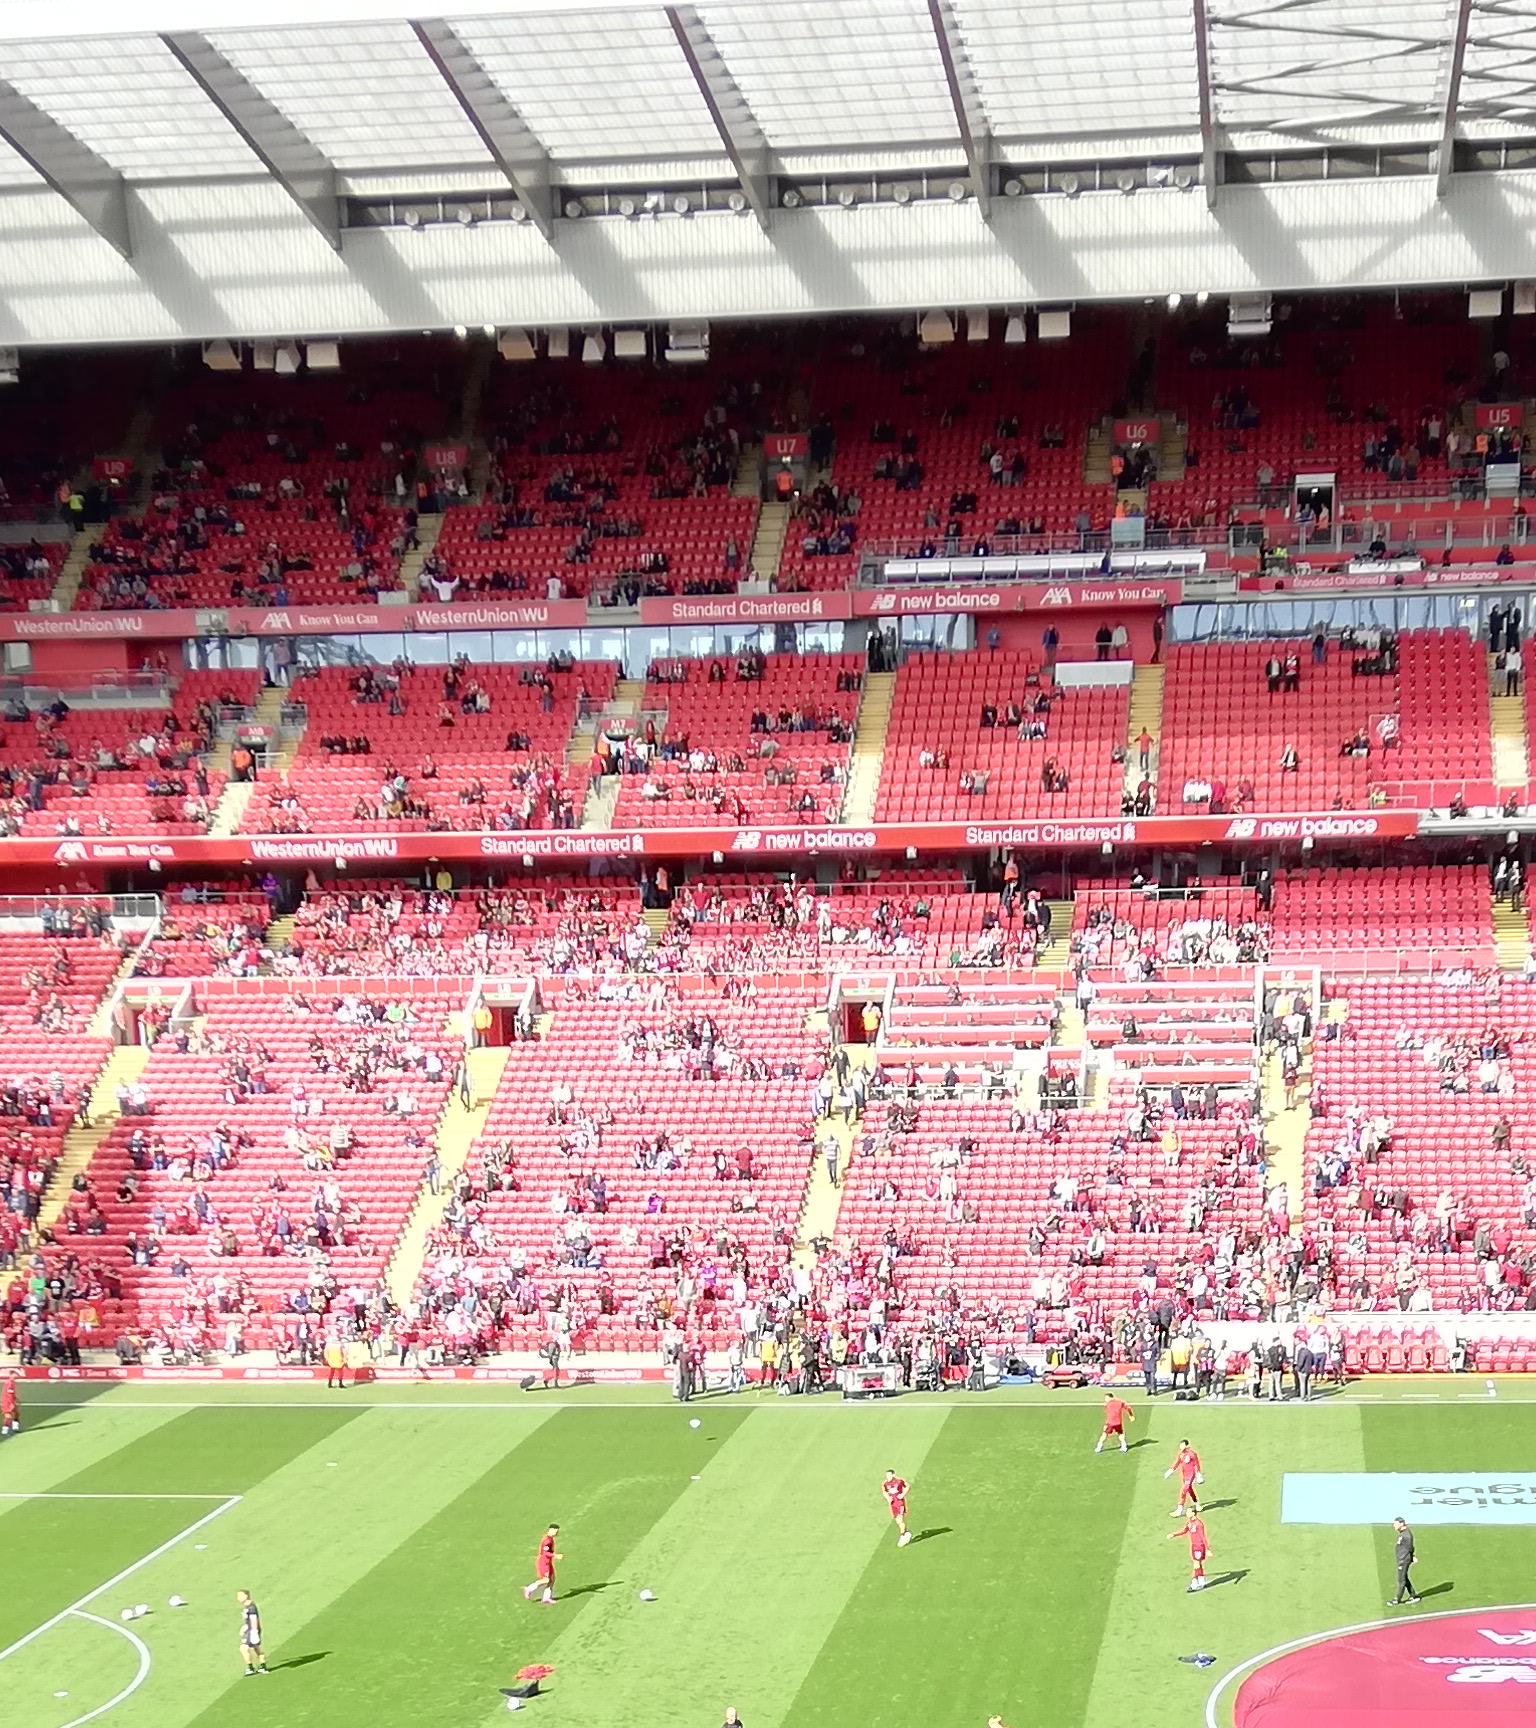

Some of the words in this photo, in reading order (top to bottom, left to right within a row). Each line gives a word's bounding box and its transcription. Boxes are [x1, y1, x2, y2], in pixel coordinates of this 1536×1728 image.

[1489, 409, 1510, 423] U5
[1126, 425, 1147, 439] U6
[777, 440, 796, 454] U7
[436, 451, 456, 464] U8
[1294, 577, 1333, 588] Standard
[1335, 575, 1378, 586] Chartered
[1440, 573, 1459, 582] new
[1461, 571, 1500, 581] balance
[901, 596, 931, 608] new
[935, 592, 999, 607] balance
[1040, 587, 1072, 604] AXA
[1081, 589, 1113, 601] Know
[1115, 588, 1138, 600] You
[672, 601, 736, 617] Standard
[740, 599, 810, 615] Chartered
[260, 612, 292, 629] AXA
[299, 614, 330, 626] Know
[332, 614, 355, 626] You
[357, 613, 378, 625] Can
[611, 719, 626, 729] M7
[967, 826, 1038, 843] Standard
[1042, 823, 1122, 841] Chartered
[1261, 821, 1297, 835] new
[1301, 817, 1377, 833] balance
[481, 837, 551, 854] Standard
[554, 835, 631, 853] Chartered
[766, 834, 800, 848] new
[803, 830, 876, 847] balance
[55, 842, 89, 860] AXA
[93, 844, 123, 857] Know
[126, 844, 147, 857] You
[150, 844, 174, 856] Can
